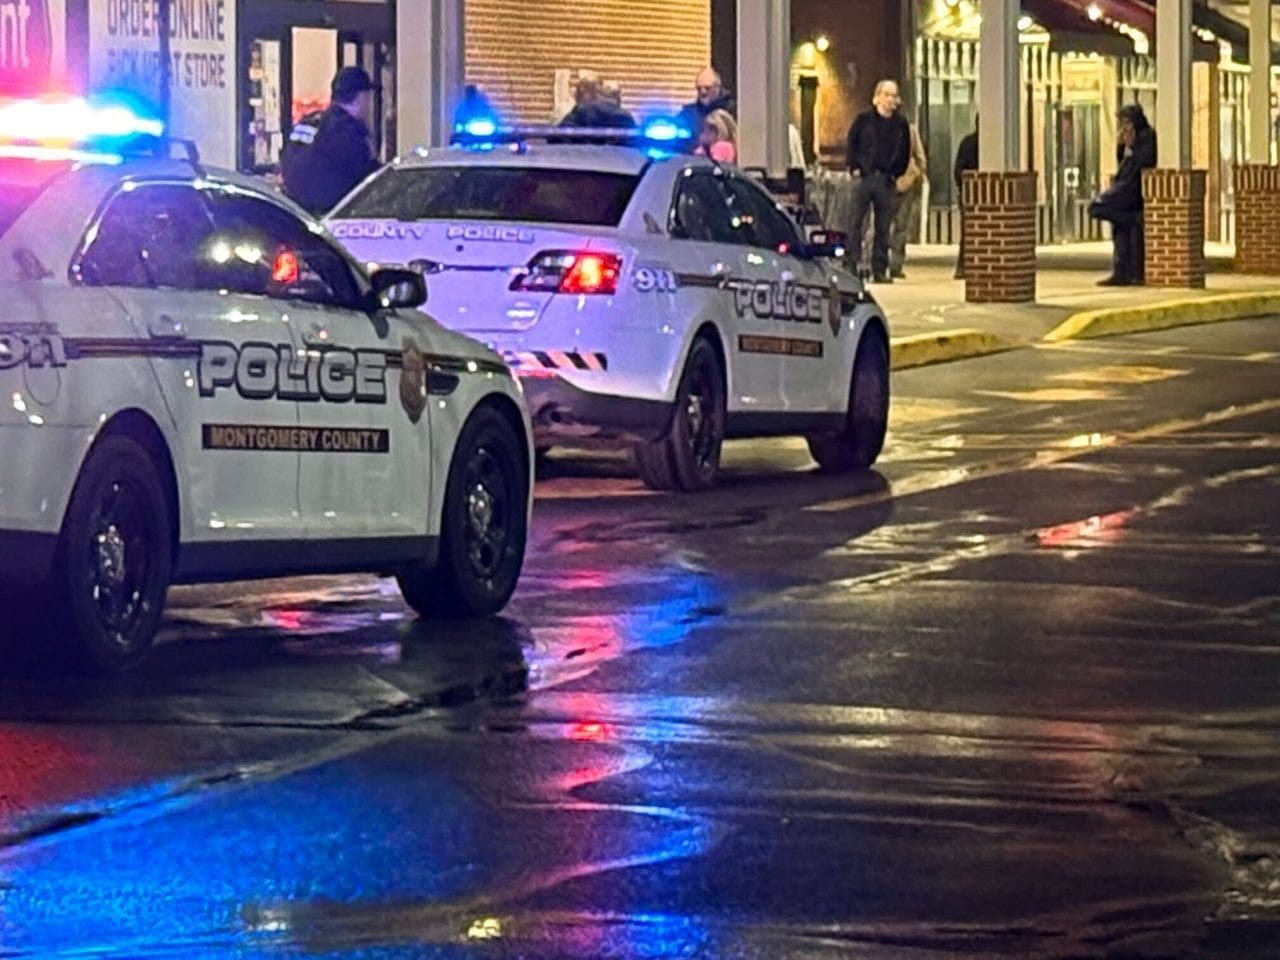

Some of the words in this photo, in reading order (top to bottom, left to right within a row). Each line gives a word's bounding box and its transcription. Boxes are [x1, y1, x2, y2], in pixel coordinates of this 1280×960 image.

[184, 51, 225, 88] STORE
[332, 222, 425, 240] COUNTY
[446, 224, 535, 244] POLICE
[634, 268, 678, 293] 911
[728, 280, 824, 324] POLICE
[199, 341, 387, 404] POLICE
[211, 426, 318, 450] MONTGOMERY
[322, 430, 382, 451] COUNTY
